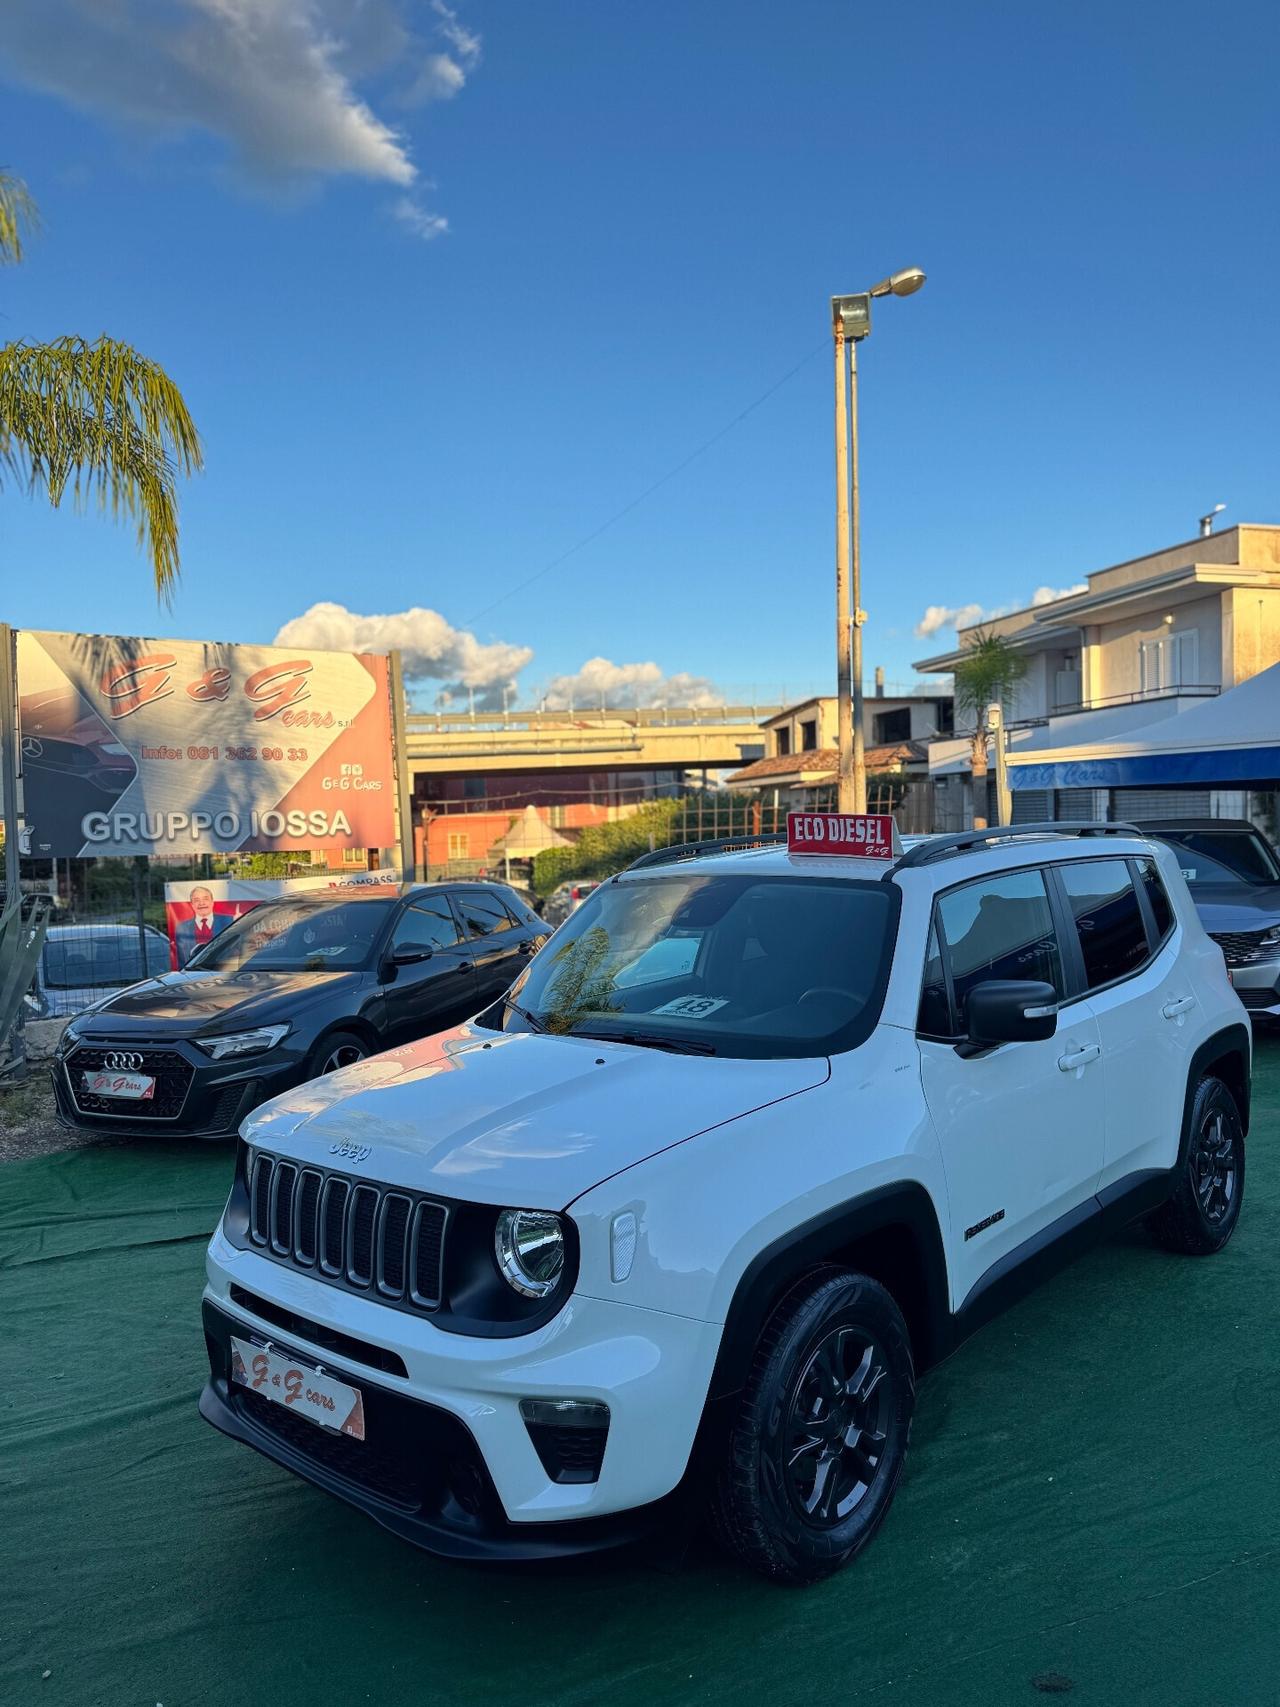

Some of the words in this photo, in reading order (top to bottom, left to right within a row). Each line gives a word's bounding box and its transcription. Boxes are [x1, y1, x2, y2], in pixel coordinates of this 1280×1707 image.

[99, 653, 177, 720] G
[185, 667, 231, 702] &
[244, 659, 313, 722] G
[281, 709, 337, 729] cars
[141, 745, 183, 760] Info:
[187, 746, 219, 761] 081
[225, 746, 258, 761] 362
[262, 747, 284, 761] 90
[288, 748, 308, 761] 33
[81, 810, 241, 843] GRUPPO
[251, 809, 352, 840] IOSSA
[794, 817, 825, 841] ECO
[827, 818, 886, 845] DIESEL
[328, 1138, 373, 1165] Jeep
[964, 1208, 1005, 1242] RENEGADE
[252, 1354, 270, 1389] G
[284, 1369, 305, 1405] G
